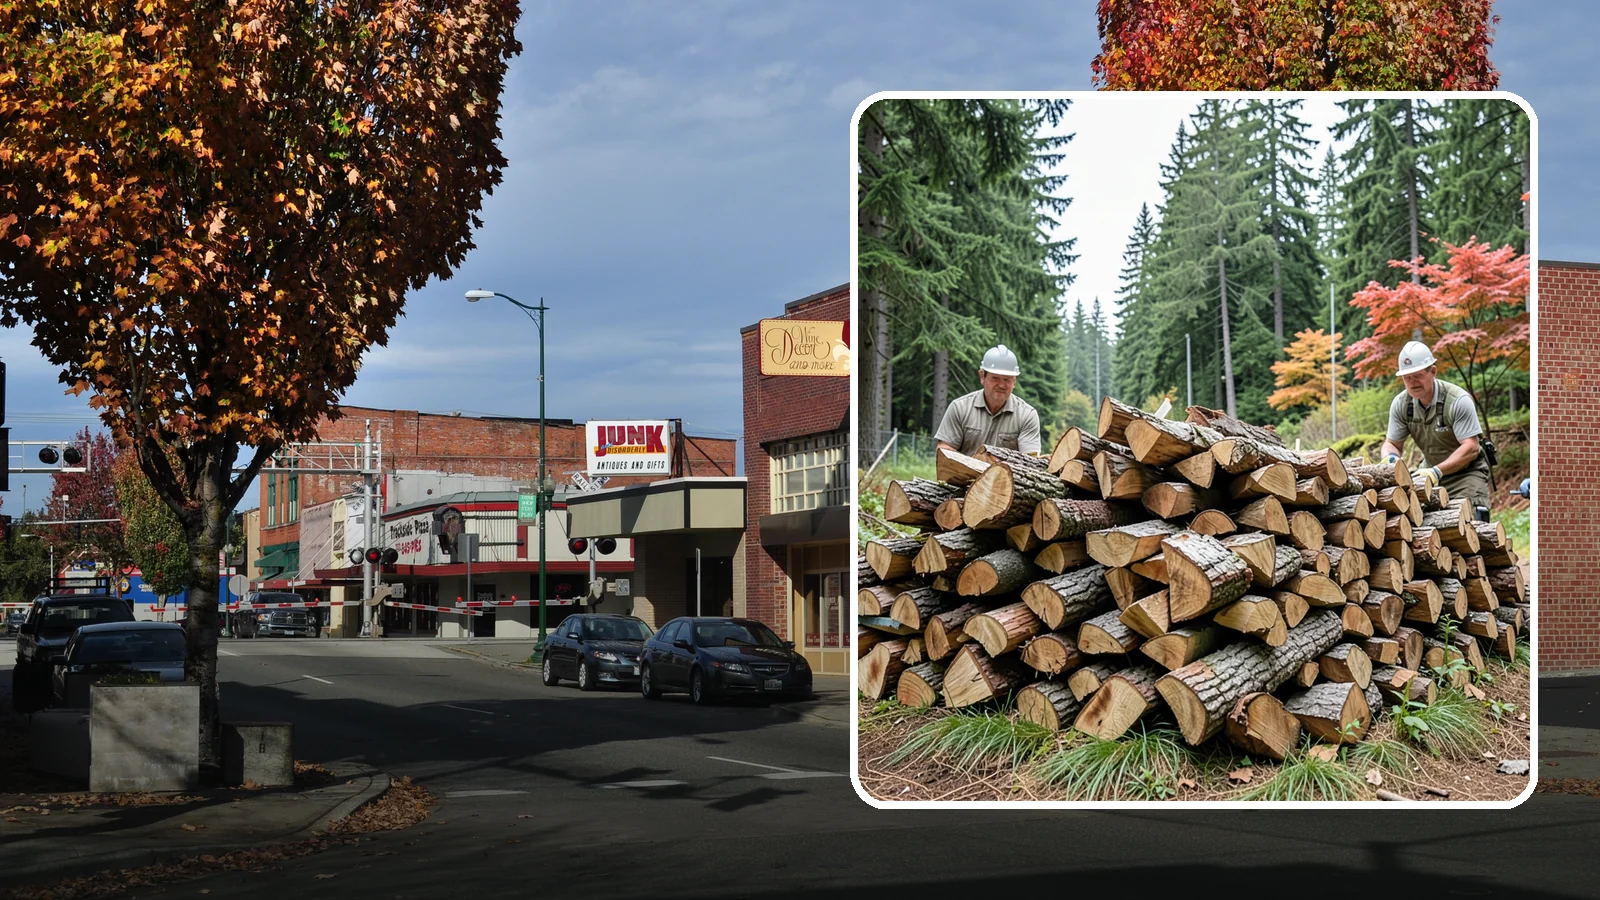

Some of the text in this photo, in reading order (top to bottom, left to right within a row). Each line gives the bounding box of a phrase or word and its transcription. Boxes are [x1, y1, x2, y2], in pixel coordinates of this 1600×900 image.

[765, 328, 831, 365] Decor
[595, 425, 665, 457] JUNK
[607, 446, 646, 454] DISORDERLY
[597, 460, 665, 470] ANTIQUES AND GIFTS
[390, 519, 429, 539] Trackside Pizza
